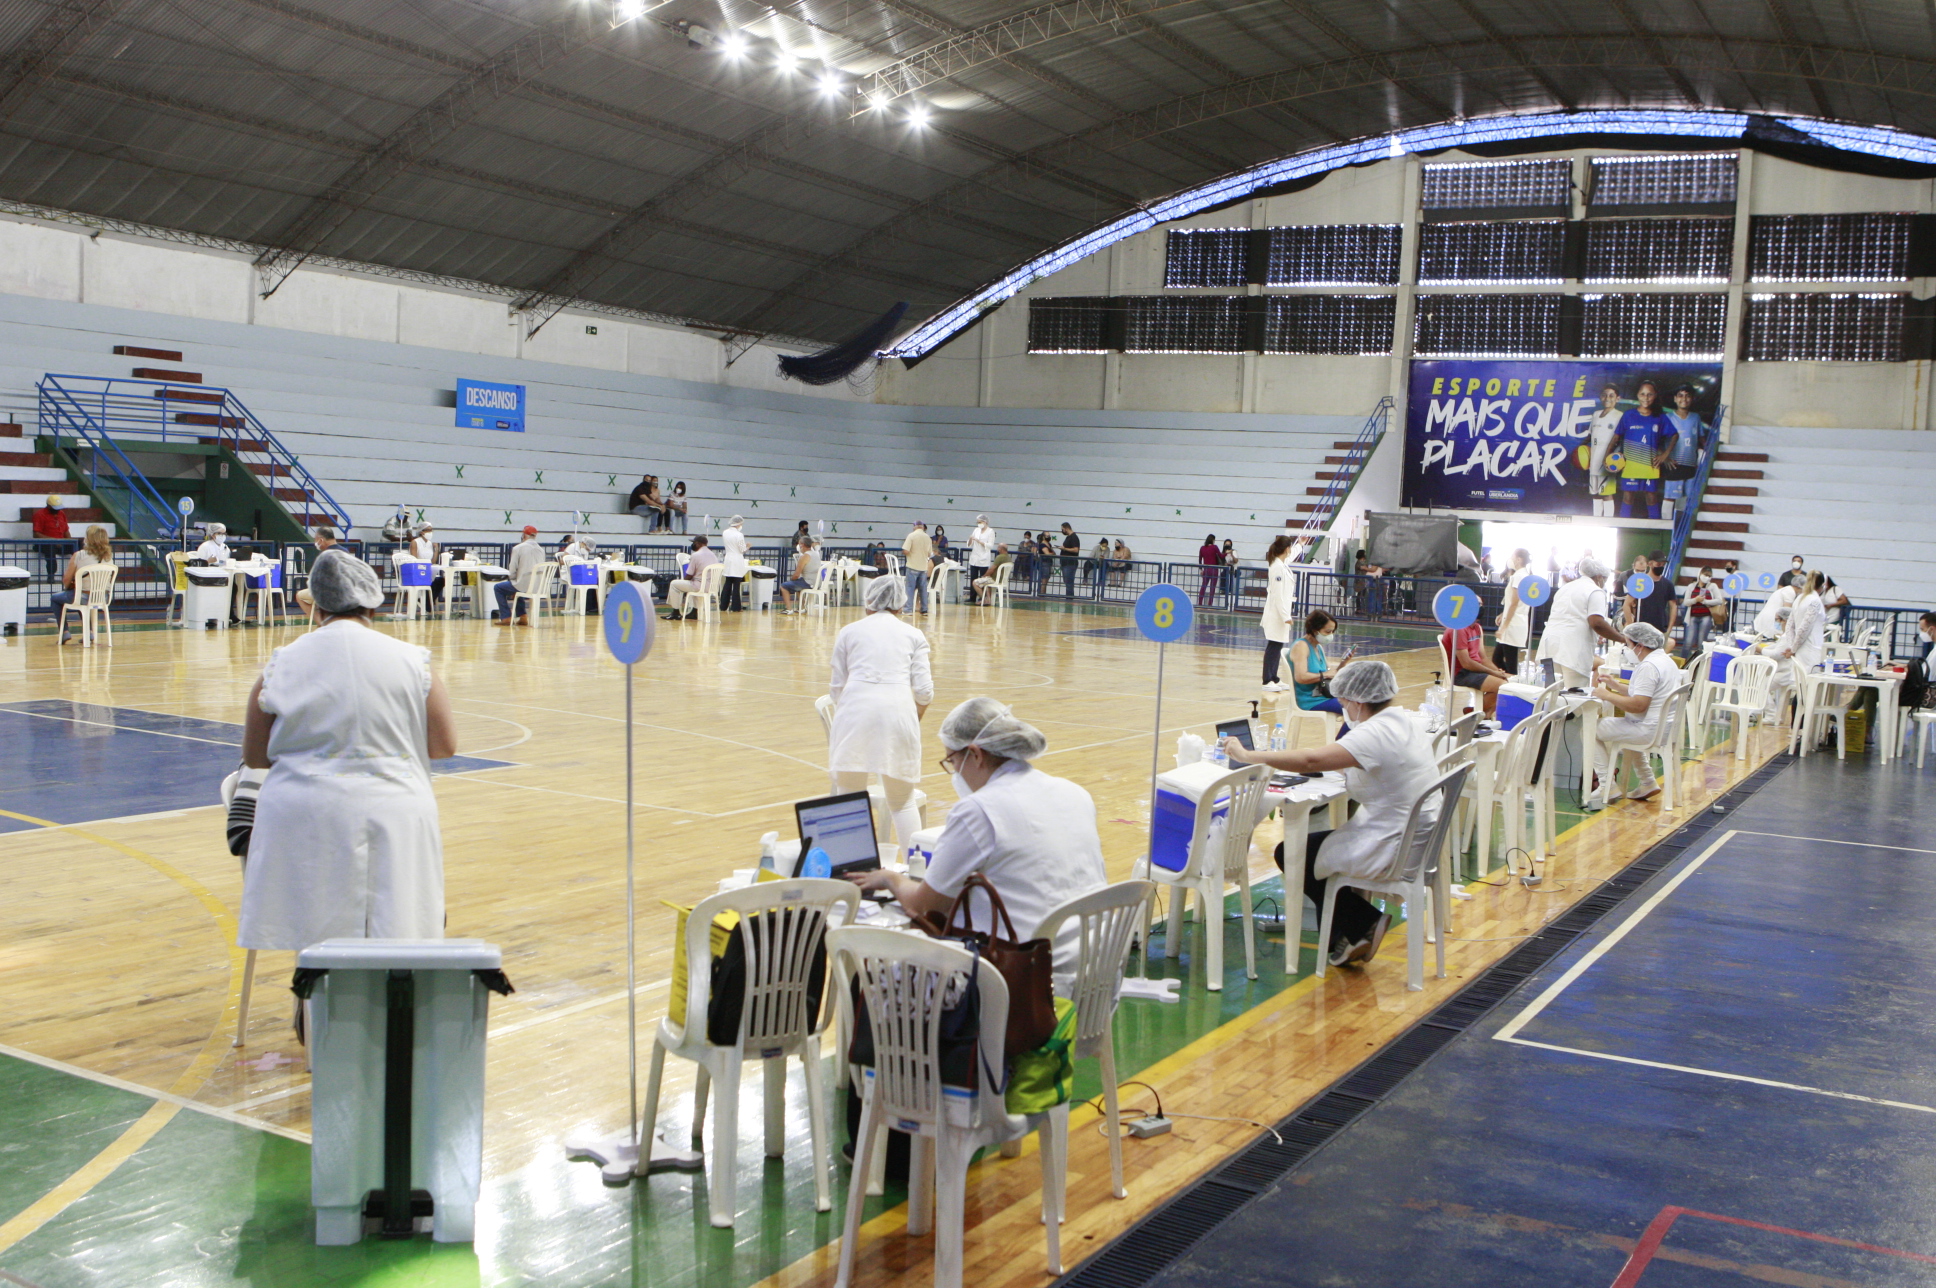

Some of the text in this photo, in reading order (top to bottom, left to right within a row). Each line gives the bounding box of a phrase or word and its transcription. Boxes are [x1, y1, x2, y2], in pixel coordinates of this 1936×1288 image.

[1432, 375, 1586, 398] ESPORTE É
[466, 387, 517, 410] DESCANSO
[1425, 397, 1596, 440] MAIS QUE
[1420, 439, 1567, 486] PLACAR
[181, 501, 190, 511] 15
[1527, 582, 1540, 599] 6
[1635, 578, 1645, 592] 5
[1729, 579, 1736, 590] 4
[1763, 576, 1771, 586] 2
[1153, 597, 1175, 628] 8
[1450, 595, 1465, 618] 7
[617, 601, 633, 643] 9
